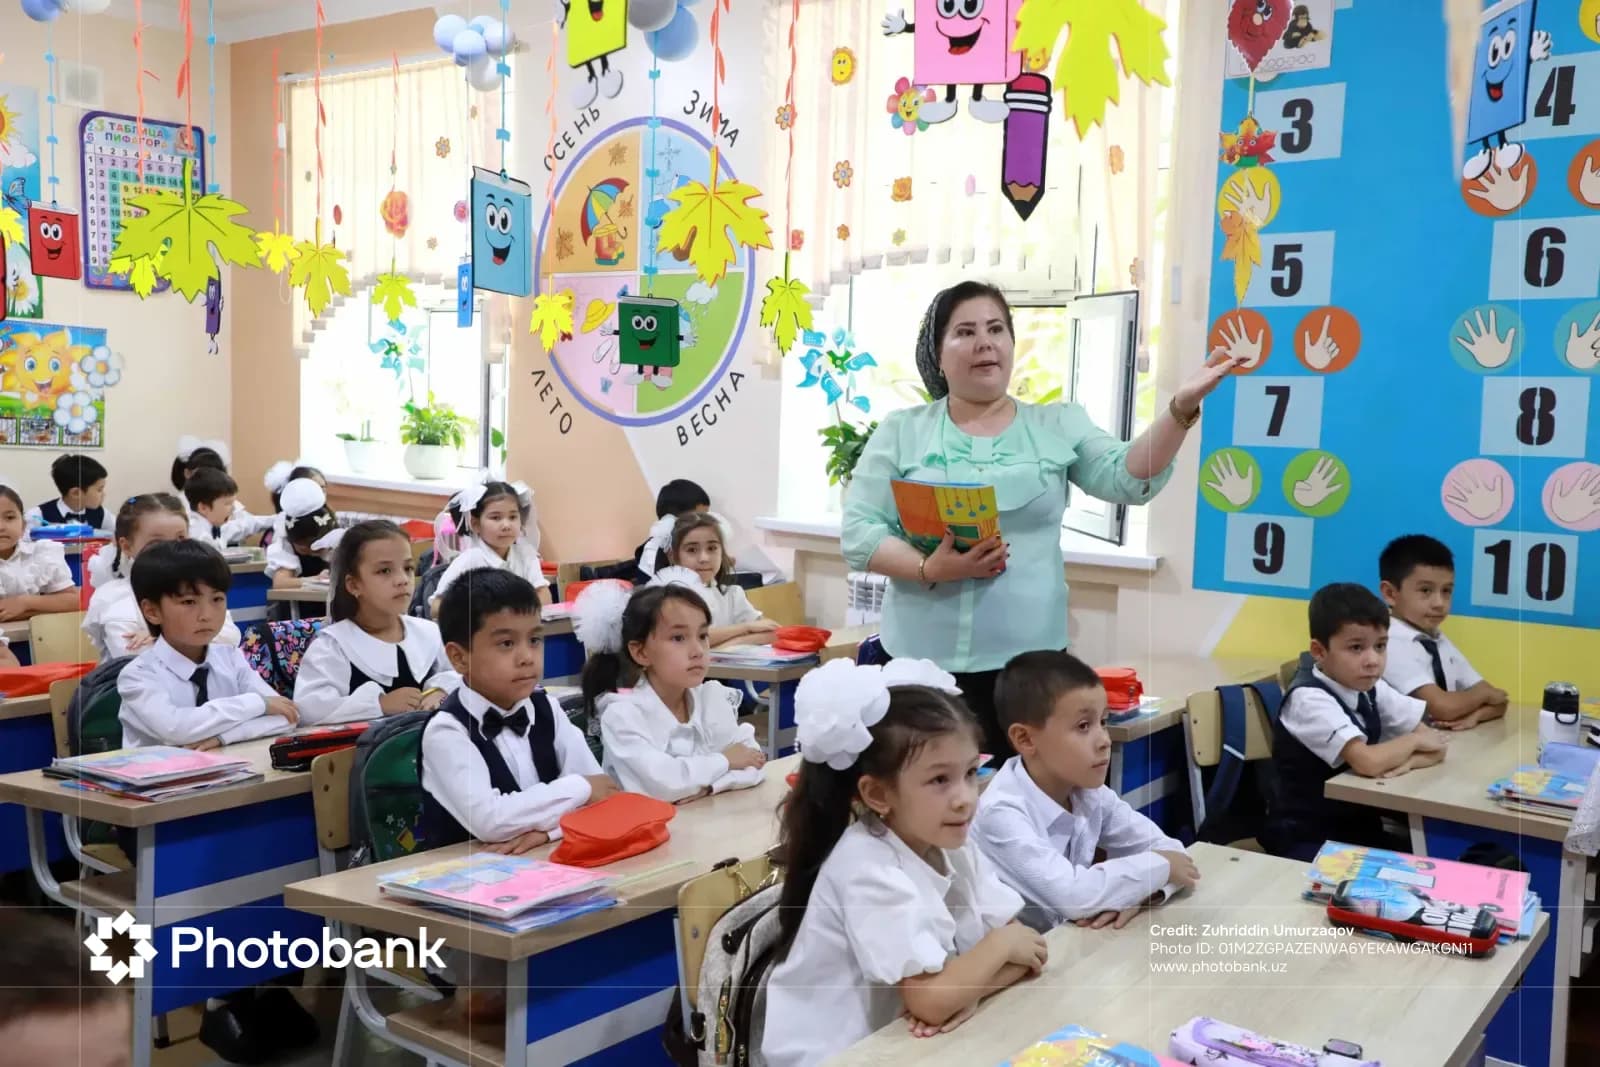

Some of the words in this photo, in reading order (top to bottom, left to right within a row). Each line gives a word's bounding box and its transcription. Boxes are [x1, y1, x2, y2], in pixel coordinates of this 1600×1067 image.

[683, 90, 740, 148] ЗИМА
[1533, 65, 1576, 126] 4
[1280, 98, 1314, 154] 3
[1270, 243, 1303, 297] 5
[1523, 227, 1566, 288] 6
[531, 368, 573, 435] ЛЕТО
[676, 370, 744, 447] ВЕСНА
[1264, 385, 1291, 437] 7
[1515, 386, 1557, 446] 8
[1252, 521, 1286, 575] 9
[1484, 539, 1566, 602] 10
